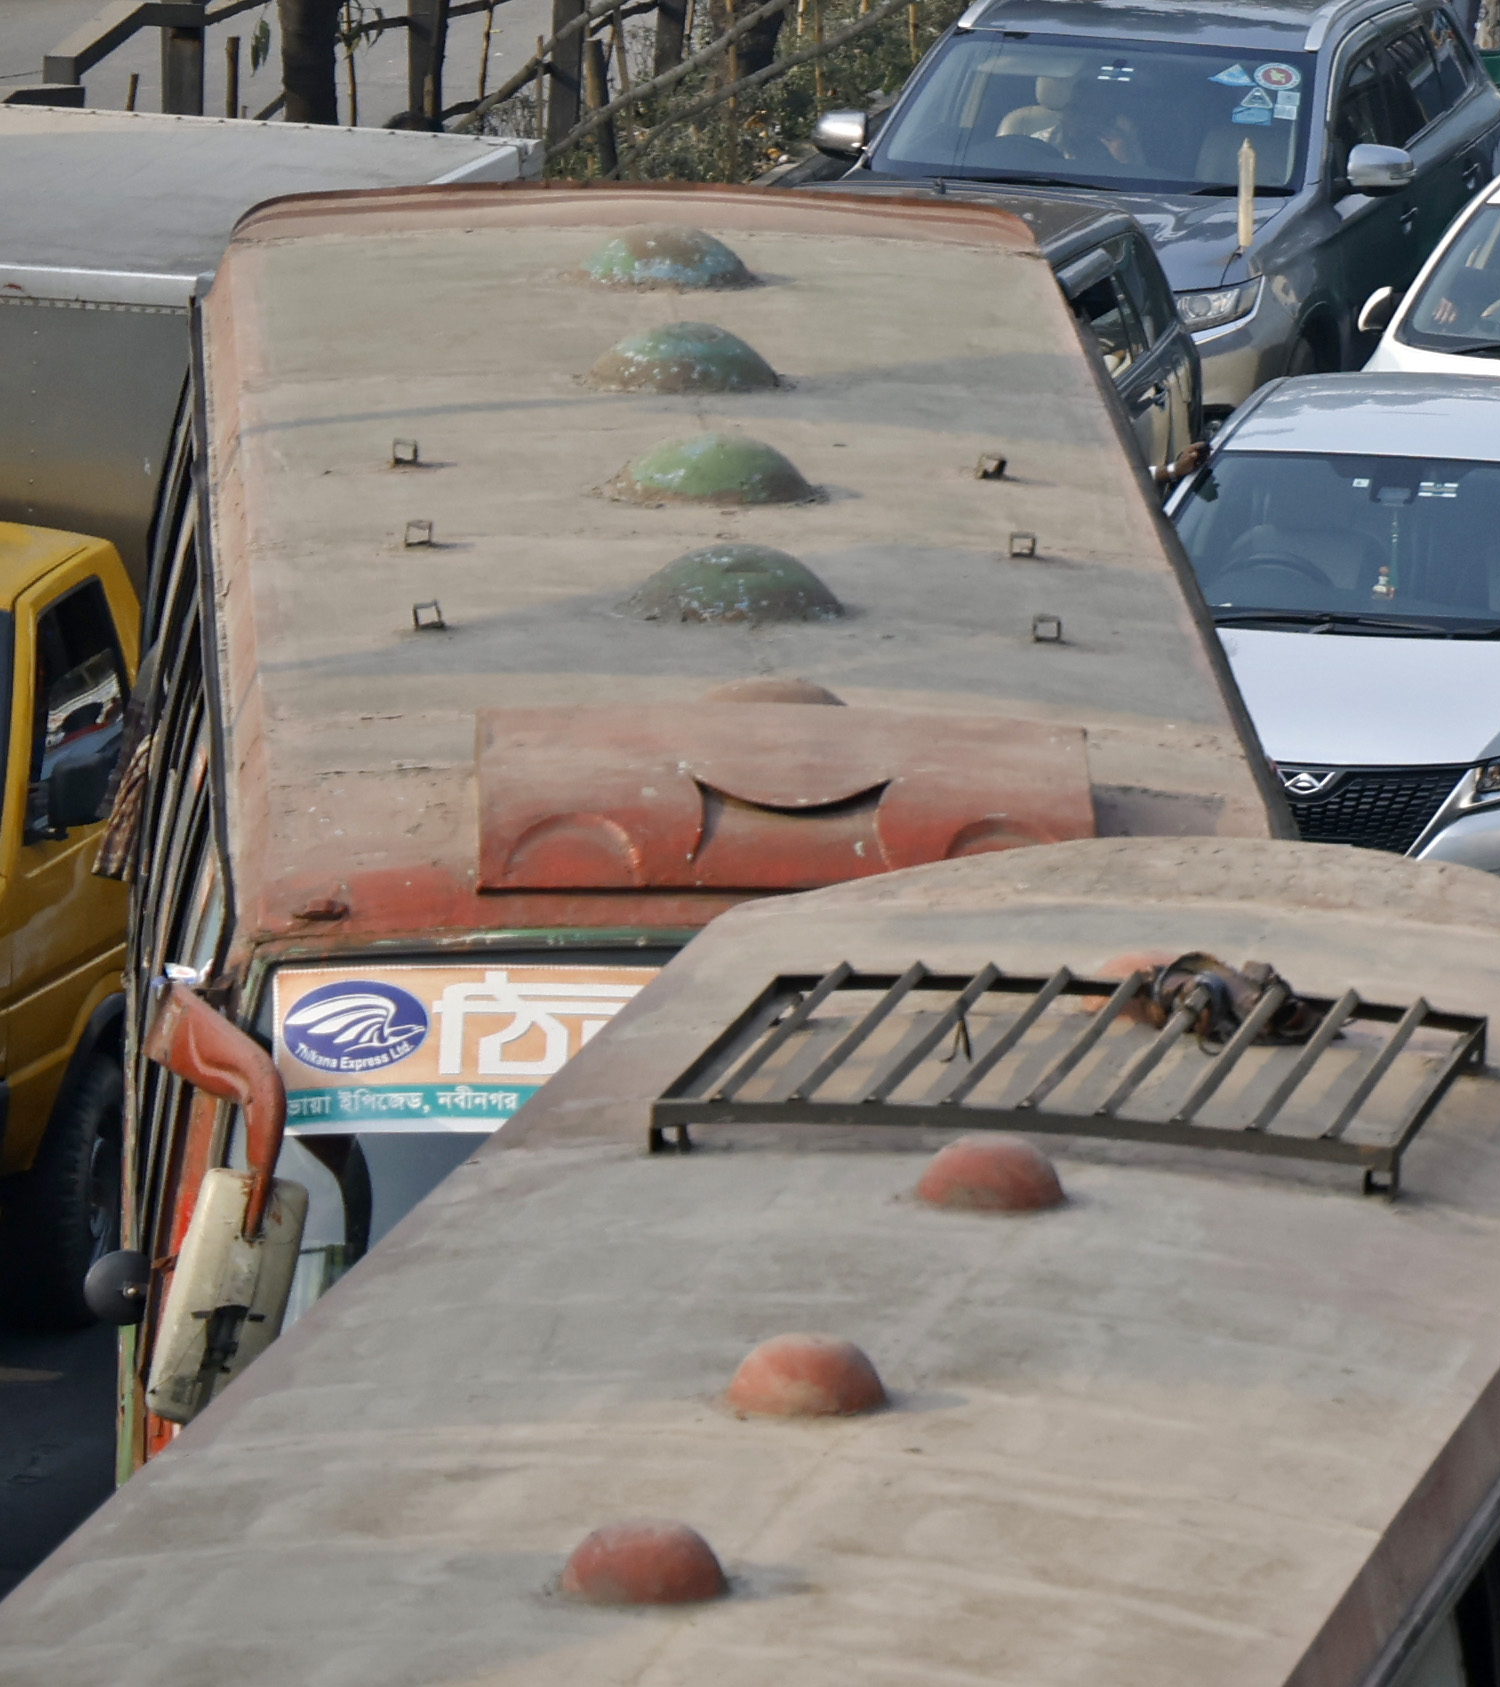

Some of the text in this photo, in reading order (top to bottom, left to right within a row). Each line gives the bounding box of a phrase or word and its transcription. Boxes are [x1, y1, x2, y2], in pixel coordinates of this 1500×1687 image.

[295, 1042, 415, 1070] Thikana Express Ltd.
[339, 1087, 431, 1114] ইপিজেড,
[437, 1085, 519, 1110] নবীনগর
